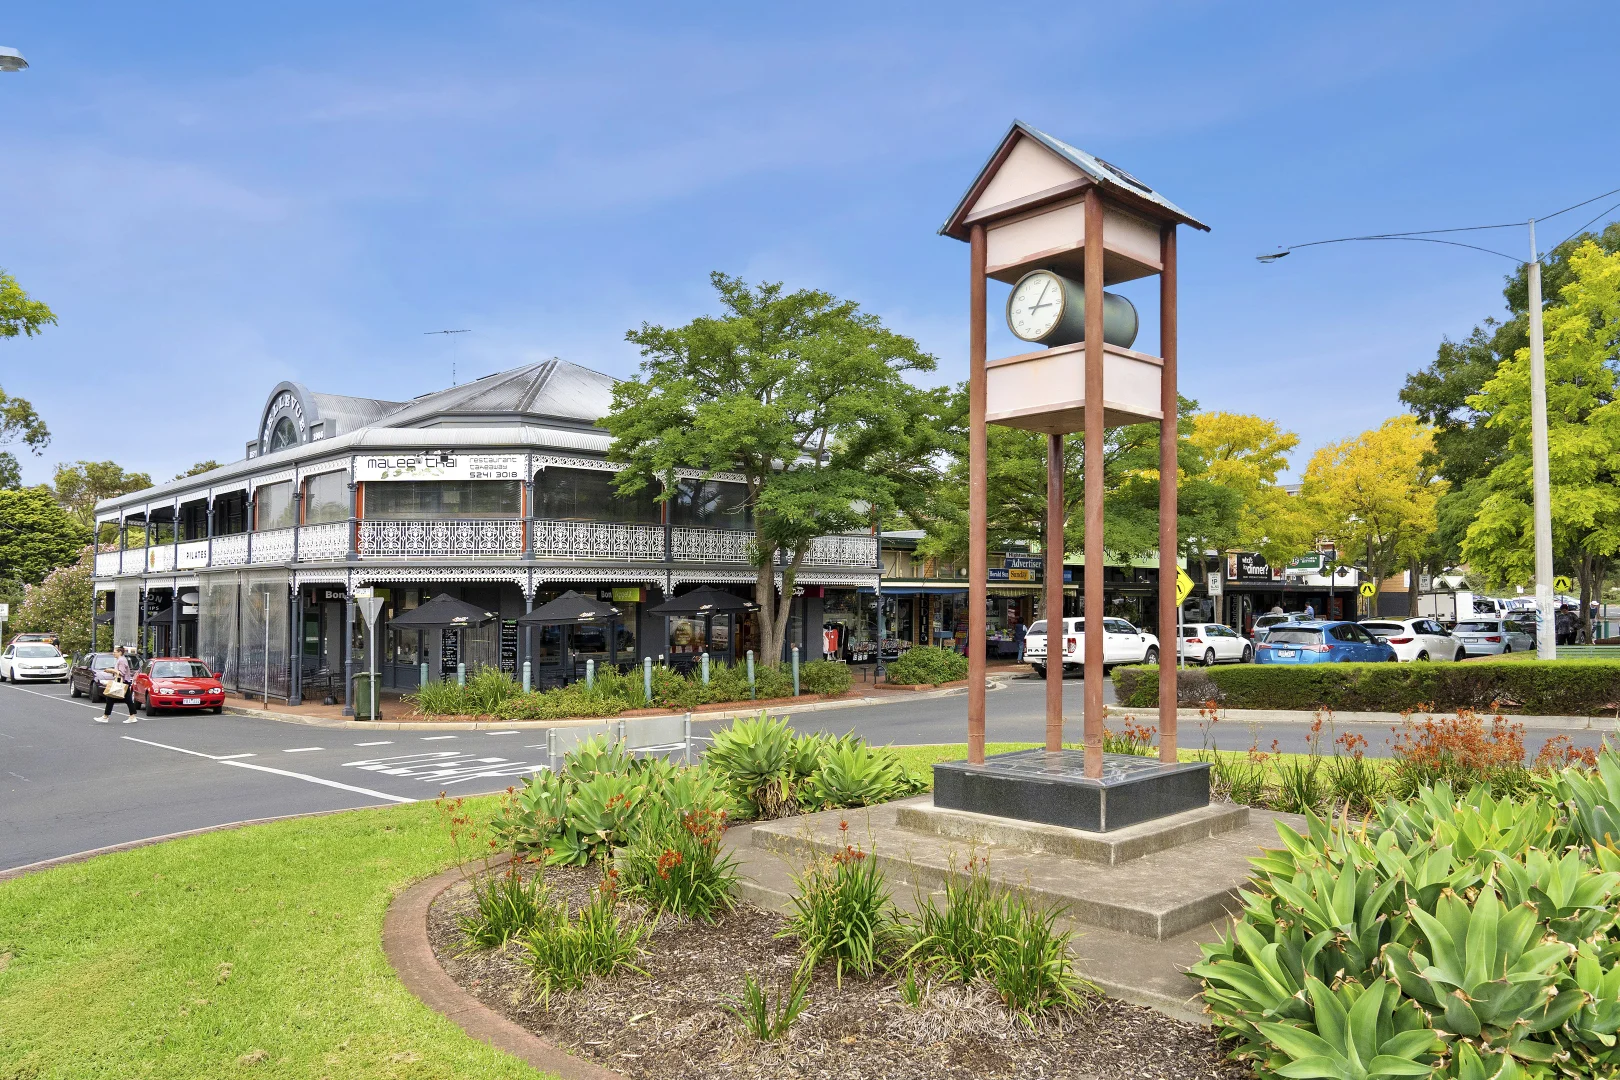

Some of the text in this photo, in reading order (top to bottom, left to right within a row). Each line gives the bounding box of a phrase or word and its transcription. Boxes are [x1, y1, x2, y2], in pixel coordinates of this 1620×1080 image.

[469, 471, 518, 479] 5241 3018
[186, 550, 207, 560] PILATES
[1011, 559, 1042, 569] Advertiser
[1247, 564, 1269, 575] dinner?
[325, 591, 344, 599] Bon
